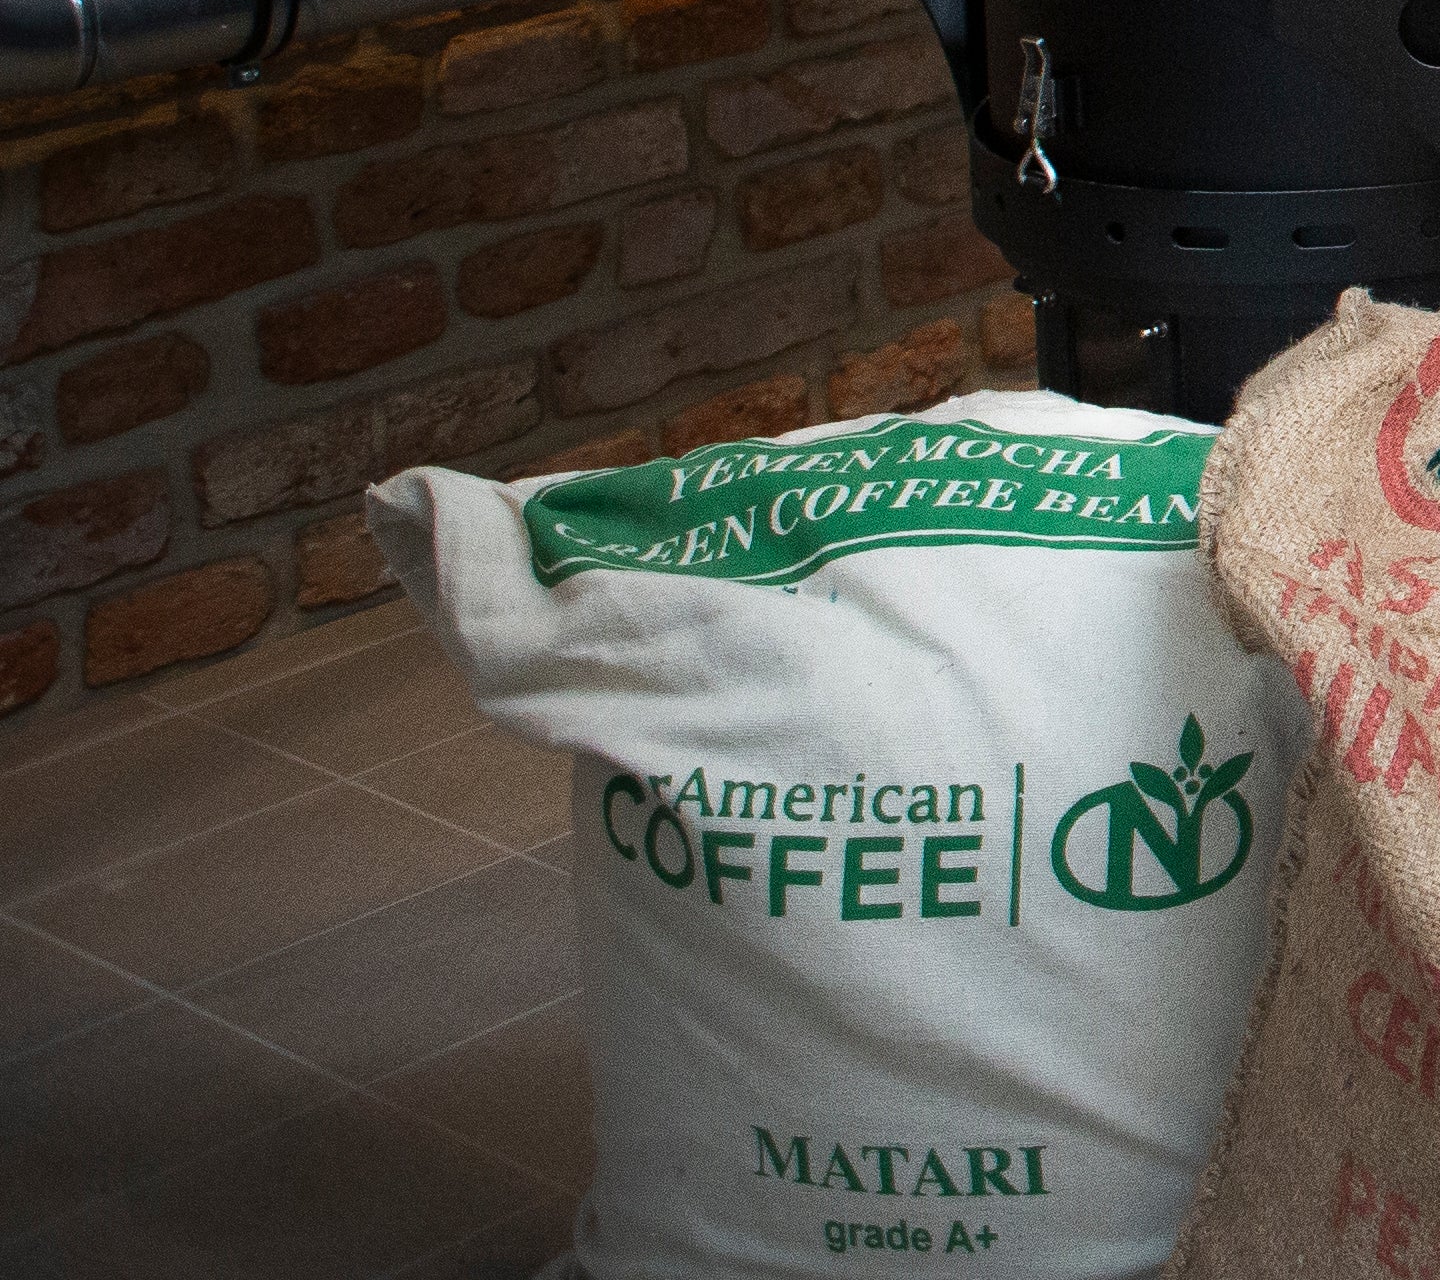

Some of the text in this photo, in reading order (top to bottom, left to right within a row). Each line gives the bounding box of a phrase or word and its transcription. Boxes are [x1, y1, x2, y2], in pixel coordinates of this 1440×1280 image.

[669, 434, 1127, 504] YEMEN MOCHA
[769, 477, 1024, 537] COFFEE
[601, 773, 984, 921] COFFEE
[752, 1125, 1052, 1198] MATARI
[823, 1218, 999, 1253] grade A+
